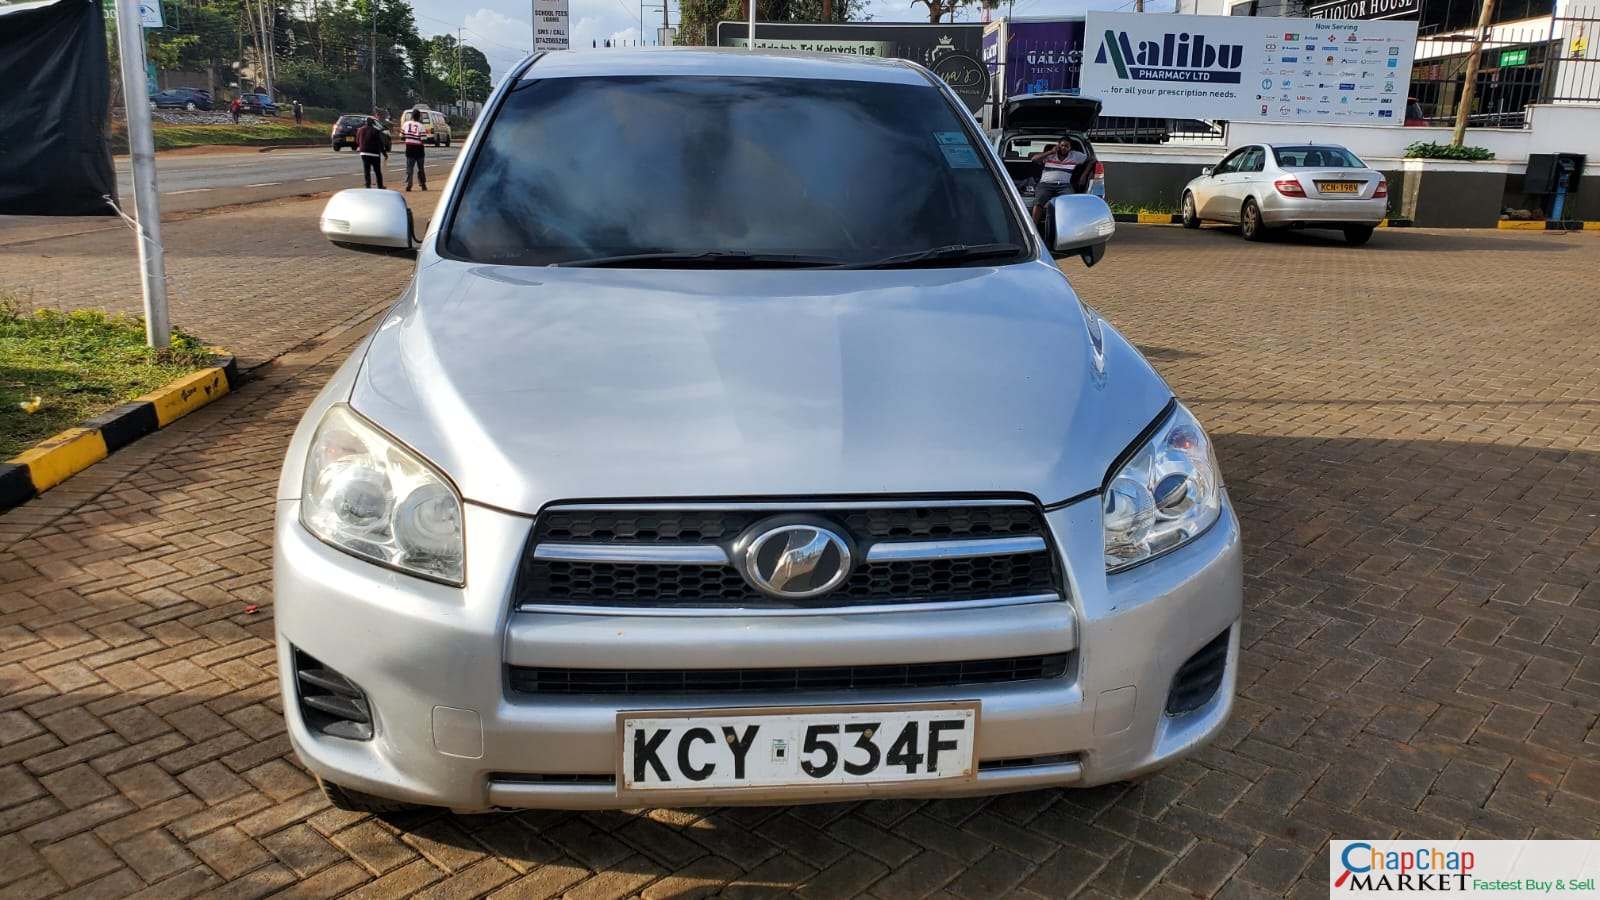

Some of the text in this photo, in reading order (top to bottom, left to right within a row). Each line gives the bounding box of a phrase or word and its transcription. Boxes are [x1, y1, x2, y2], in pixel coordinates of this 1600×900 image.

[1324, 1, 1366, 19] LIQUOR
[1331, 24, 1359, 32] Serving
[1094, 29, 1243, 79] Malibu
[1138, 69, 1210, 82] PHARMACY LTD
[1157, 88, 1208, 97] prescription
[1209, 90, 1237, 98] needs.
[633, 719, 966, 782] KCY 534F
